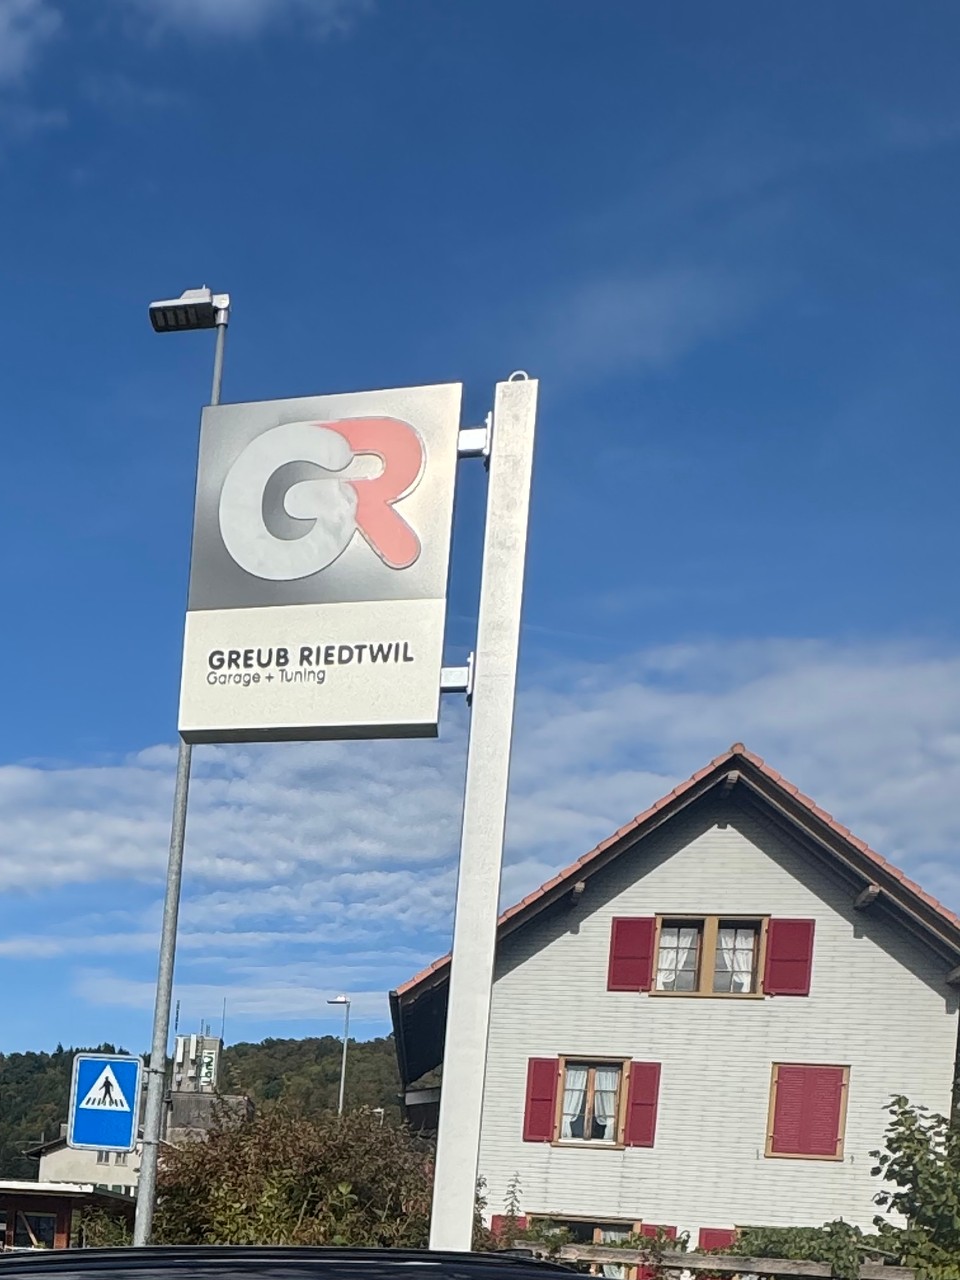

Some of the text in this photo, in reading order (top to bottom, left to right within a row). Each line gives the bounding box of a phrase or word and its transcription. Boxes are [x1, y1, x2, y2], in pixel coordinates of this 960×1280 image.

[219, 416, 426, 581] GR
[208, 642, 414, 670] GREUB RIEDTWIL
[206, 671, 261, 687] Garage
[279, 668, 326, 685] Tuning
